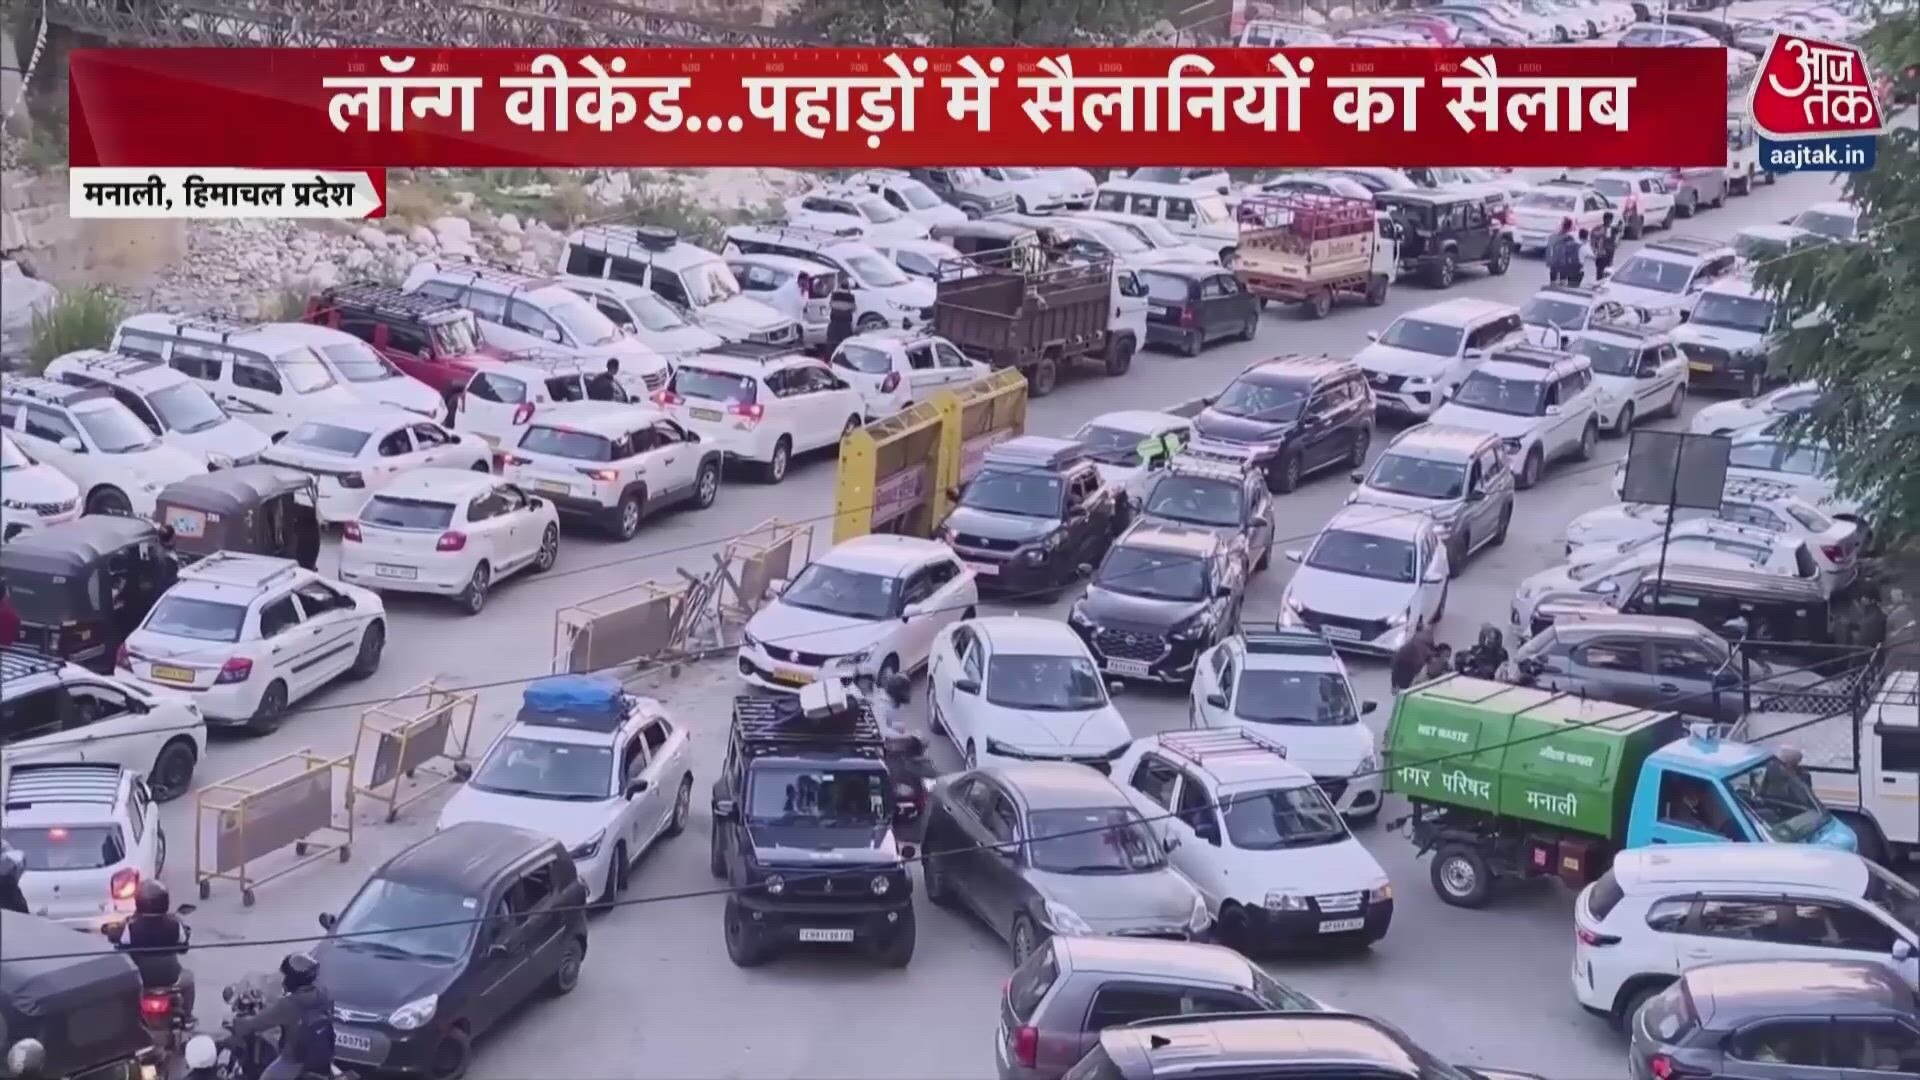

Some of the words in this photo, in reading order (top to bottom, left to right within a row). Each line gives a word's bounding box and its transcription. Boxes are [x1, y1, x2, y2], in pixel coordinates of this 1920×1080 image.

[1438, 729, 1469, 743] WASTE
[1397, 766, 1431, 787] नगर
[1441, 770, 1492, 799] परिषद
[1526, 789, 1578, 817] मनाली
